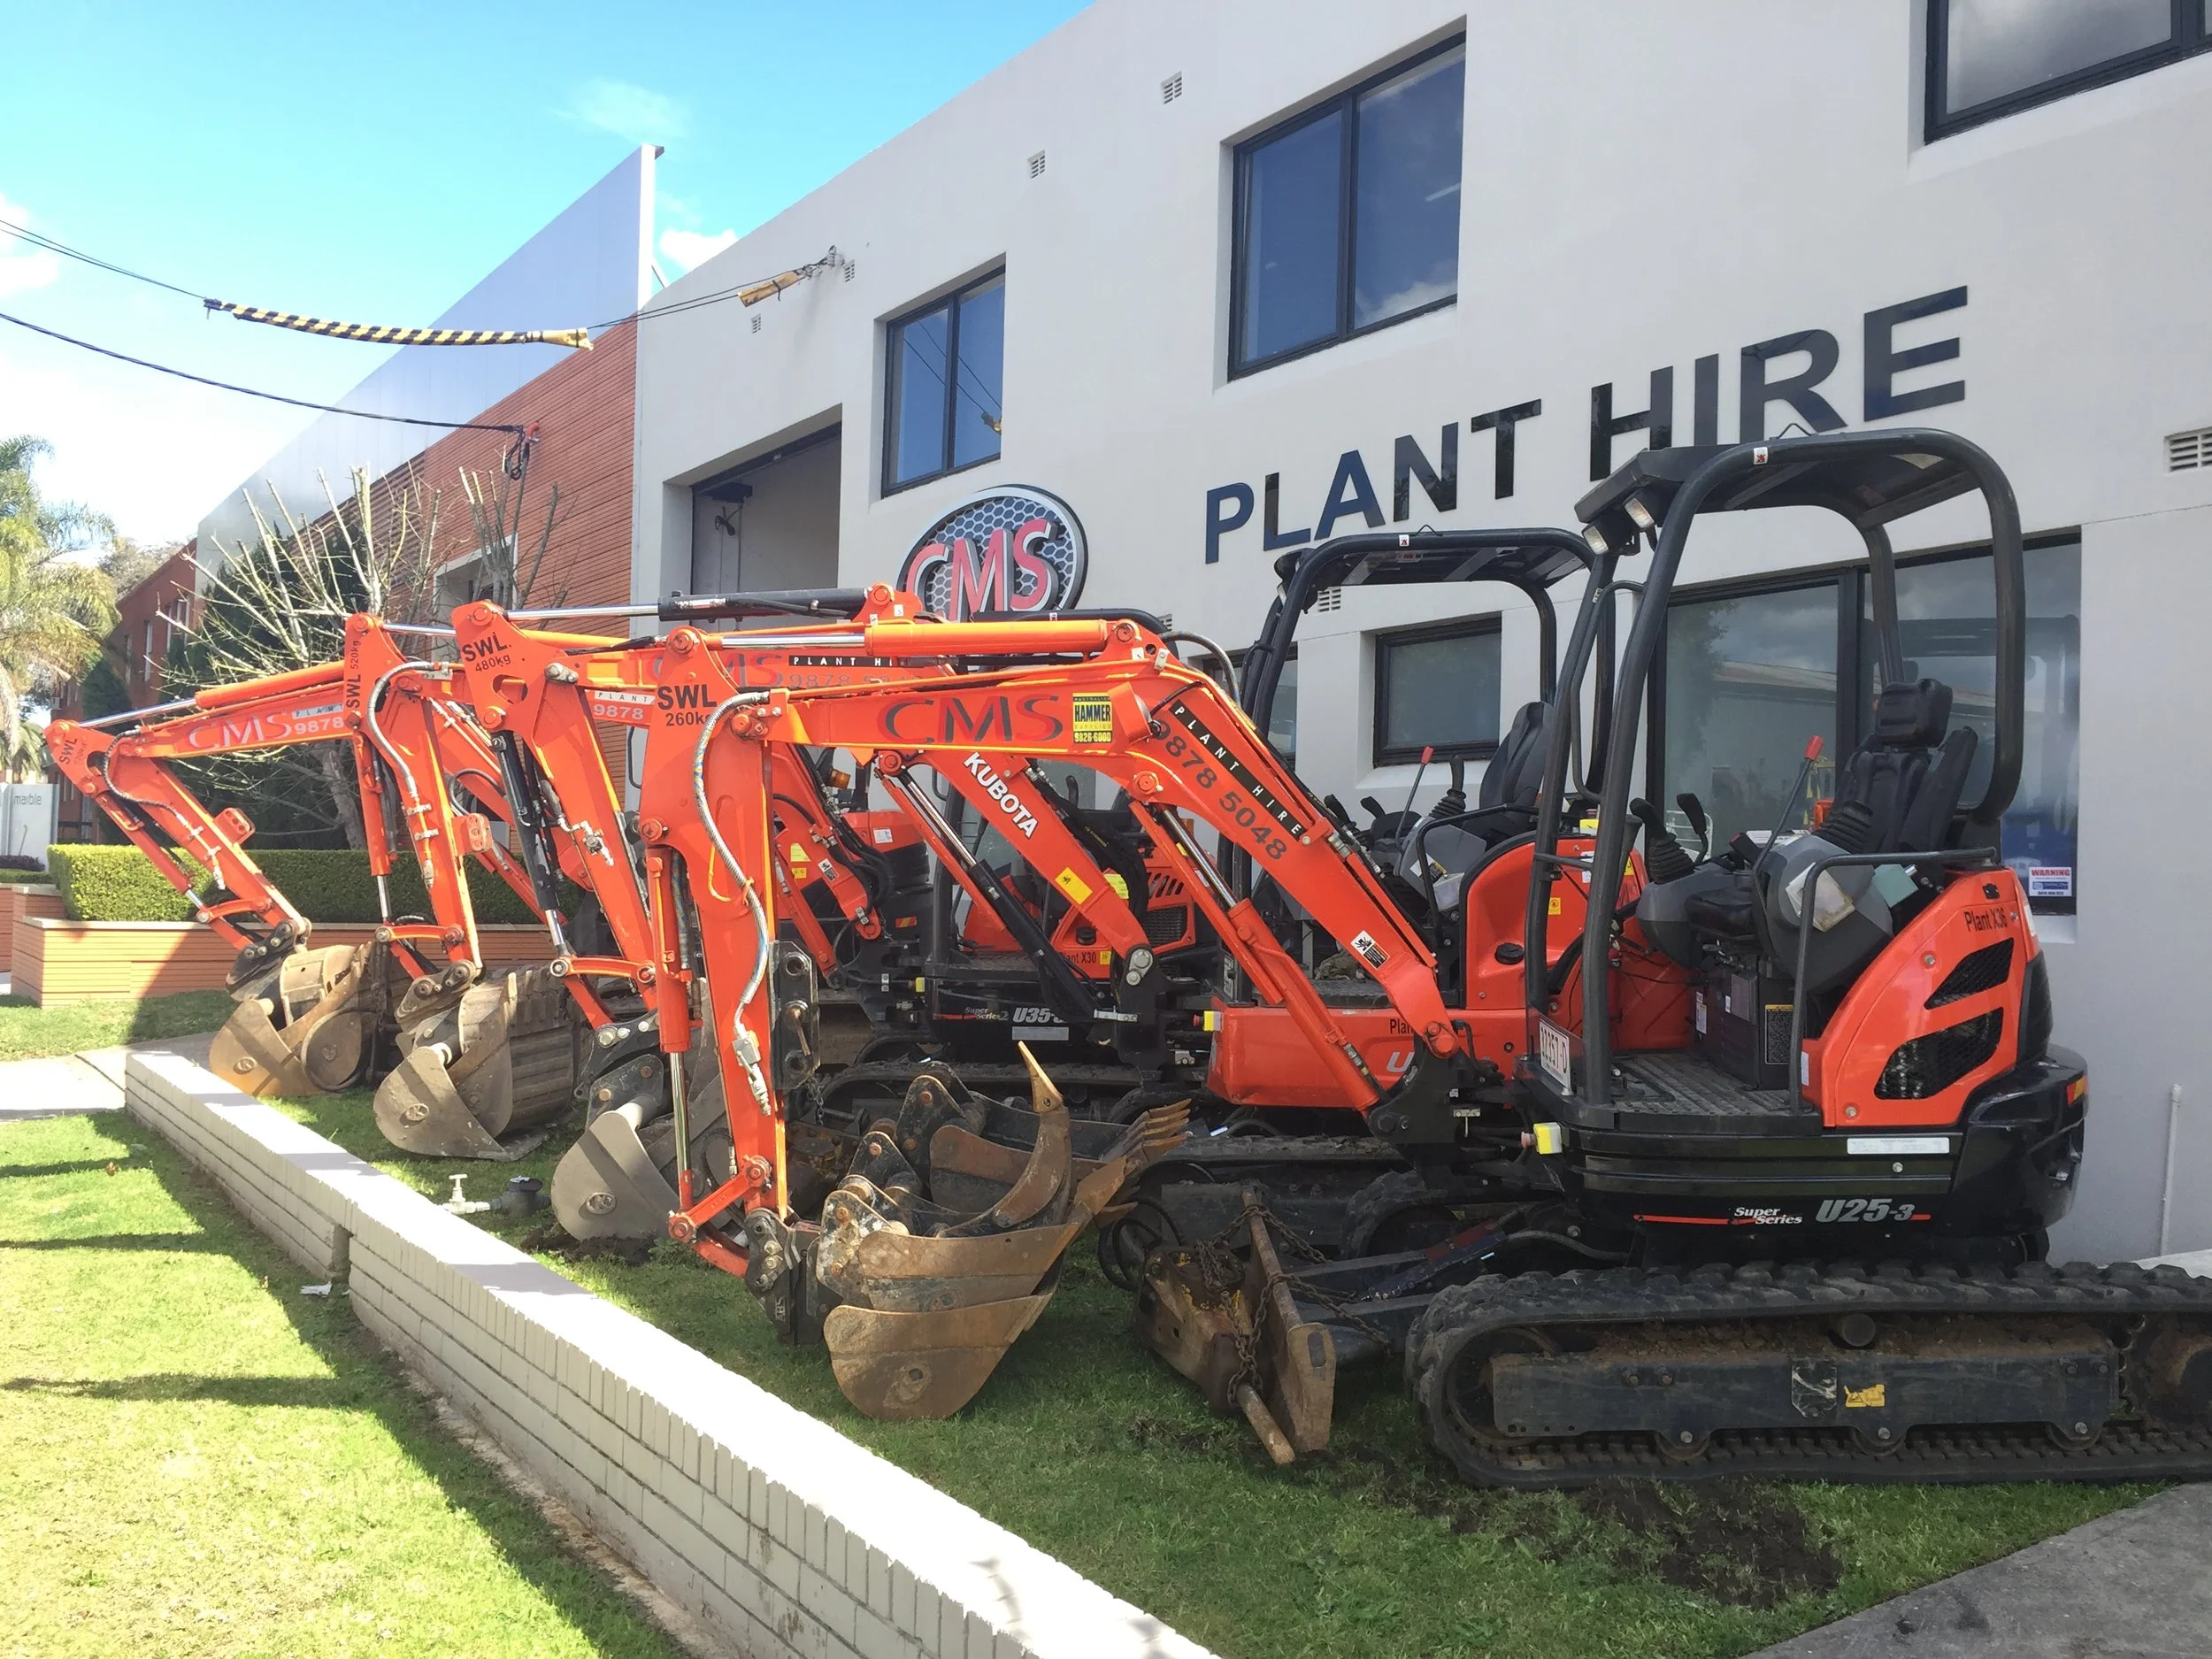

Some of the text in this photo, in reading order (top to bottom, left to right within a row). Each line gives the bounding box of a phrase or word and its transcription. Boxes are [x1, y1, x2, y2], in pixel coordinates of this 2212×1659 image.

[1204, 284, 1968, 565] PLANT HIRE
[906, 518, 1058, 622] CMS
[461, 634, 508, 663] SWL
[474, 654, 511, 673] 480kg
[794, 657, 856, 666] PLANT
[346, 640, 362, 708] SWL 520kg
[598, 692, 648, 703] PLANT
[657, 684, 718, 710] SWL
[296, 704, 340, 718] PLAN
[594, 703, 643, 720] 9878
[876, 693, 1064, 744] CMS
[1074, 704, 1110, 722] HAMMER
[188, 711, 292, 749] CMS
[294, 716, 345, 735] 9878
[58, 738, 78, 765] SWL
[1174, 706, 1302, 834] PLANT HIRE
[13, 793, 42, 805] marble
[963, 751, 1039, 840] KUBOTA
[1156, 720, 1287, 860] 9878 5048
[1964, 910, 1993, 933] Plant
[1064, 952, 1097, 964] ant X30
[964, 1006, 989, 1015] Super
[1389, 1018, 1414, 1034] Plan
[1734, 1207, 1781, 1218] Super
[1755, 1214, 1803, 1225] Series
[1816, 1198, 1916, 1223] U25-3
